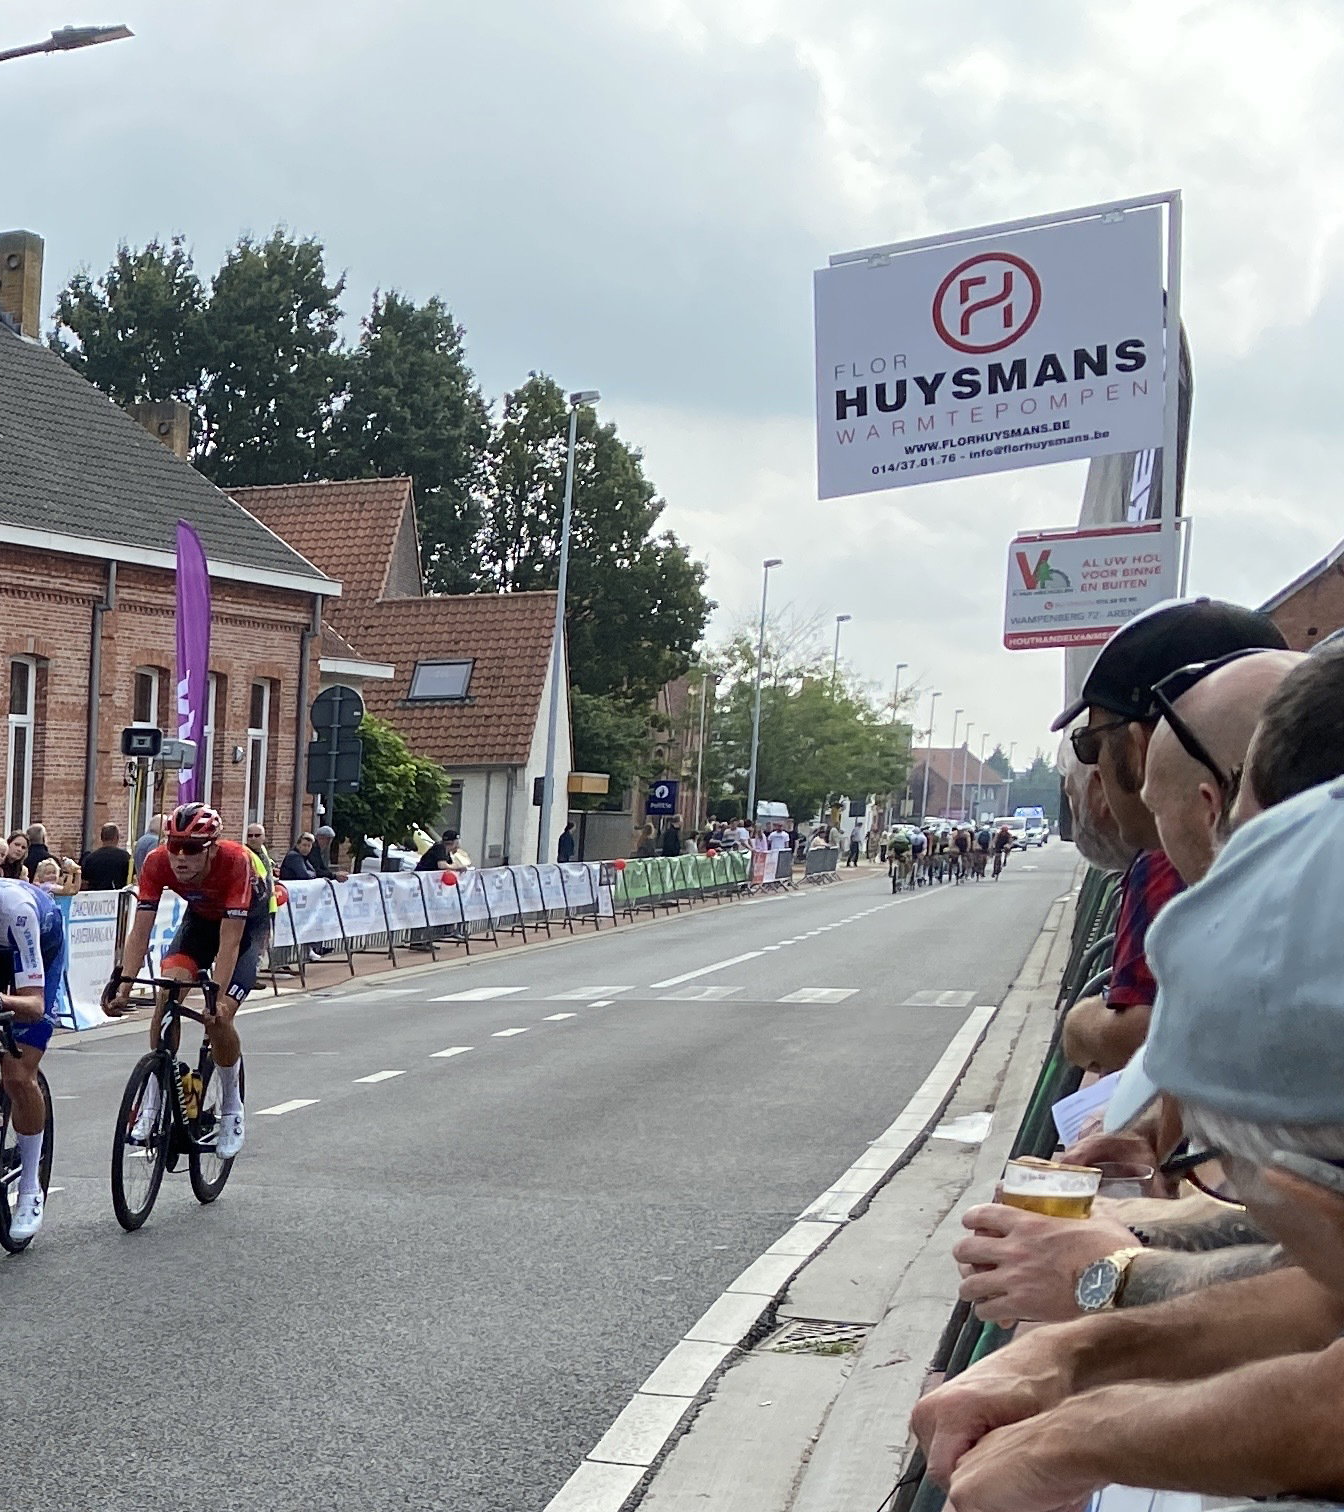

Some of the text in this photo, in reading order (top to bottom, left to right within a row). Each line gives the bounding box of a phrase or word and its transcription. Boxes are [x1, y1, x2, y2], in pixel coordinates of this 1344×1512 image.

[834, 354, 907, 380] FLOR
[835, 339, 1147, 421] HUYSMANS
[837, 379, 1150, 445] WARMTEPOMPEN
[904, 420, 1070, 455] WWW.FLORHUYSMANS.BE
[1080, 564, 1161, 579] VOOR BINNE
[1082, 559, 1100, 568] AL
[1104, 556, 1127, 567] UW
[1080, 582, 1098, 592] EN
[1102, 579, 1147, 590] BUITEN
